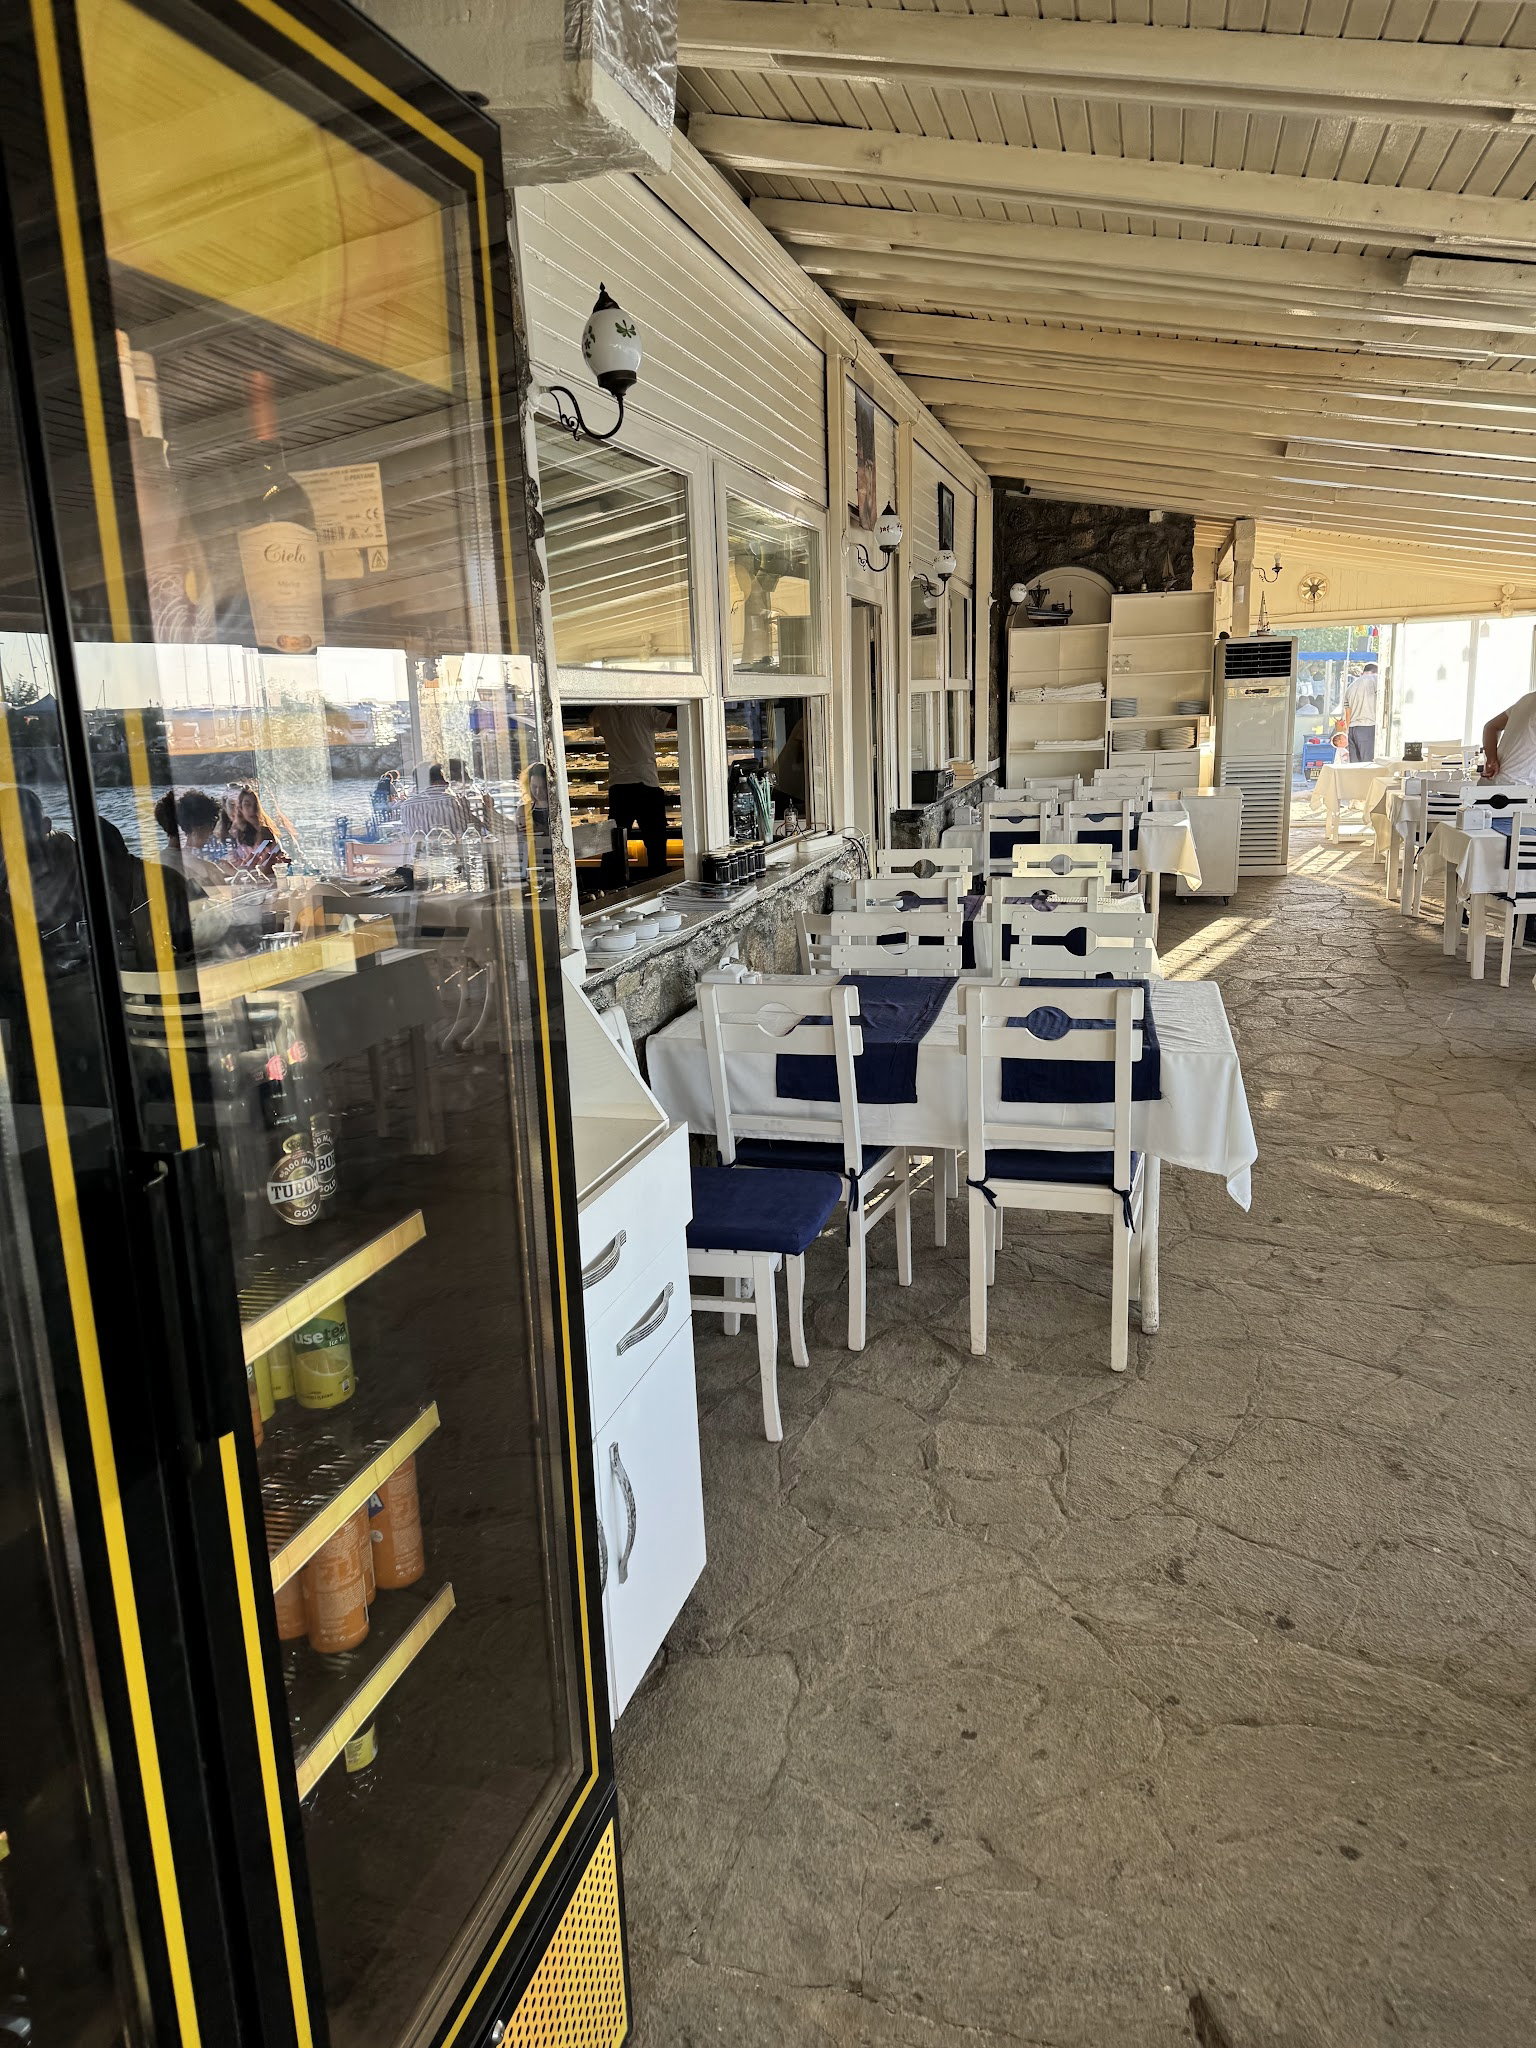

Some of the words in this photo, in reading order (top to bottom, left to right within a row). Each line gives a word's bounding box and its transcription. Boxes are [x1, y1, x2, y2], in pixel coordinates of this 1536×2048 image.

[264, 543, 306, 563] Cielo
[280, 1160, 299, 1178] %100
[294, 1204, 317, 1217] GOLD
[293, 1321, 347, 1346] usetea
